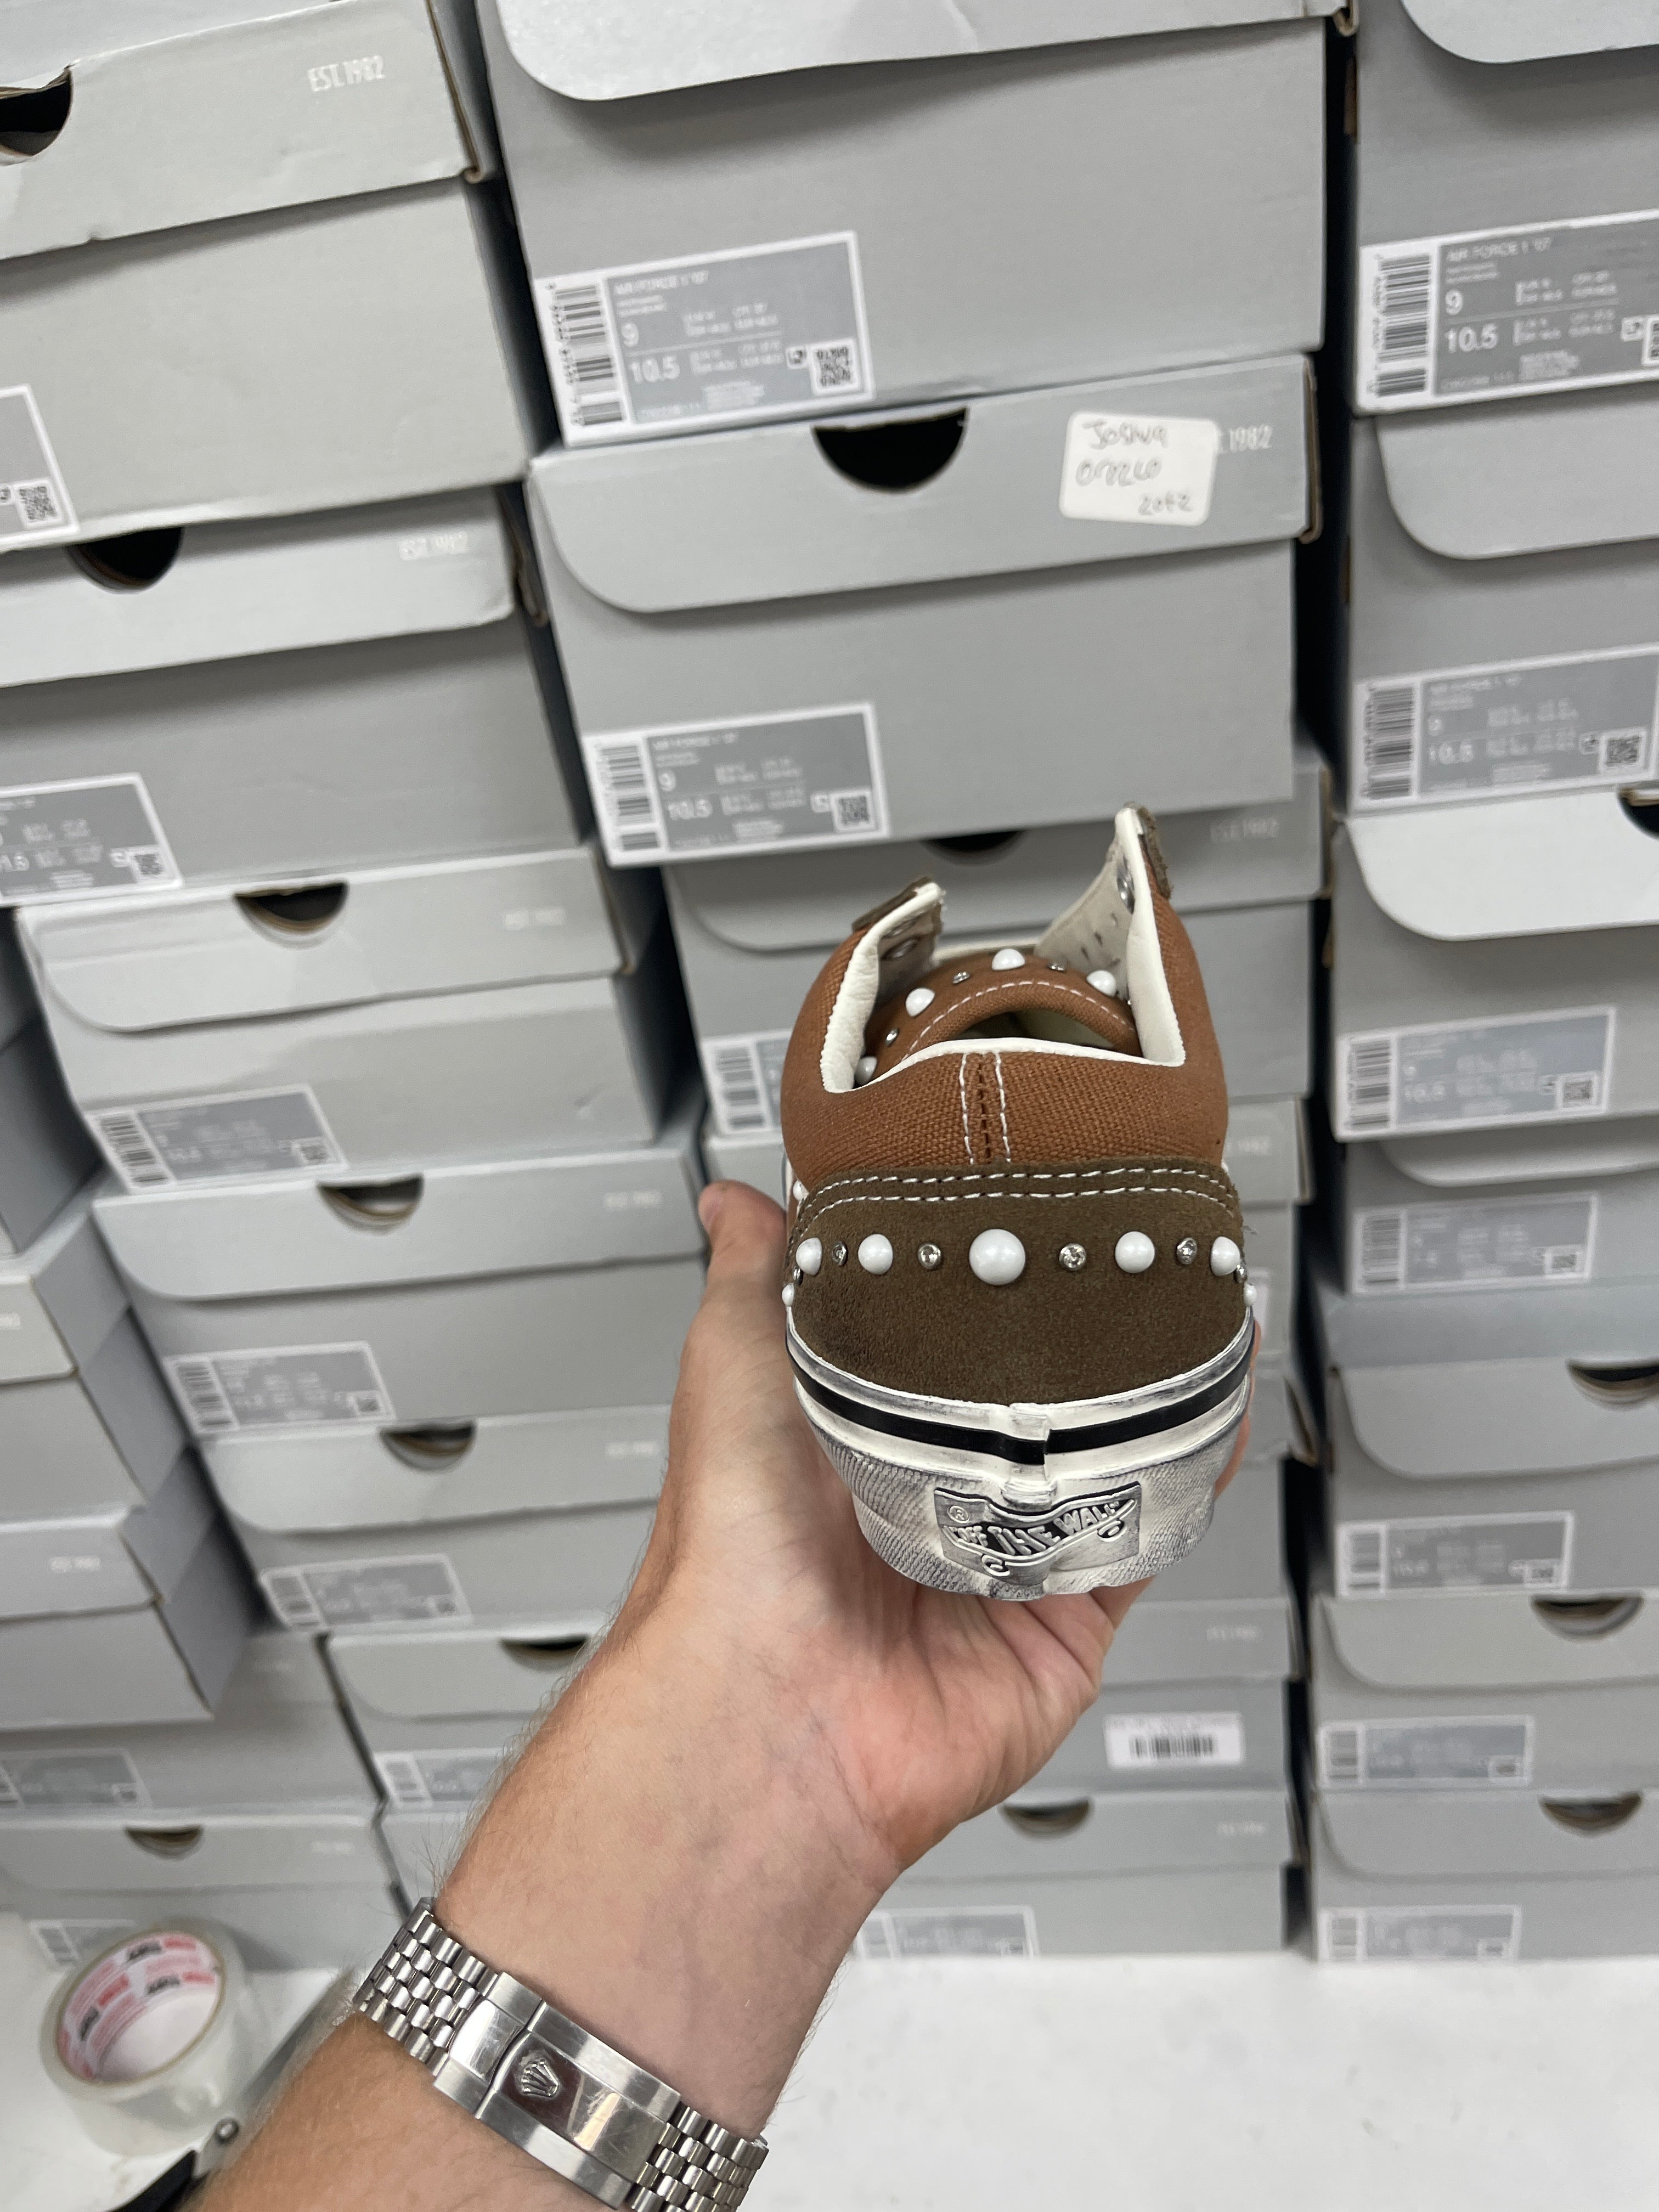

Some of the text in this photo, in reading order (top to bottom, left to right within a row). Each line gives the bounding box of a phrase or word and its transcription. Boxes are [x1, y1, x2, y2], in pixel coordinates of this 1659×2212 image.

[1444, 289, 1464, 315] 9
[621, 323, 640, 347] 9
[1444, 323, 1499, 354] 10.5
[629, 354, 680, 383] 10.5
